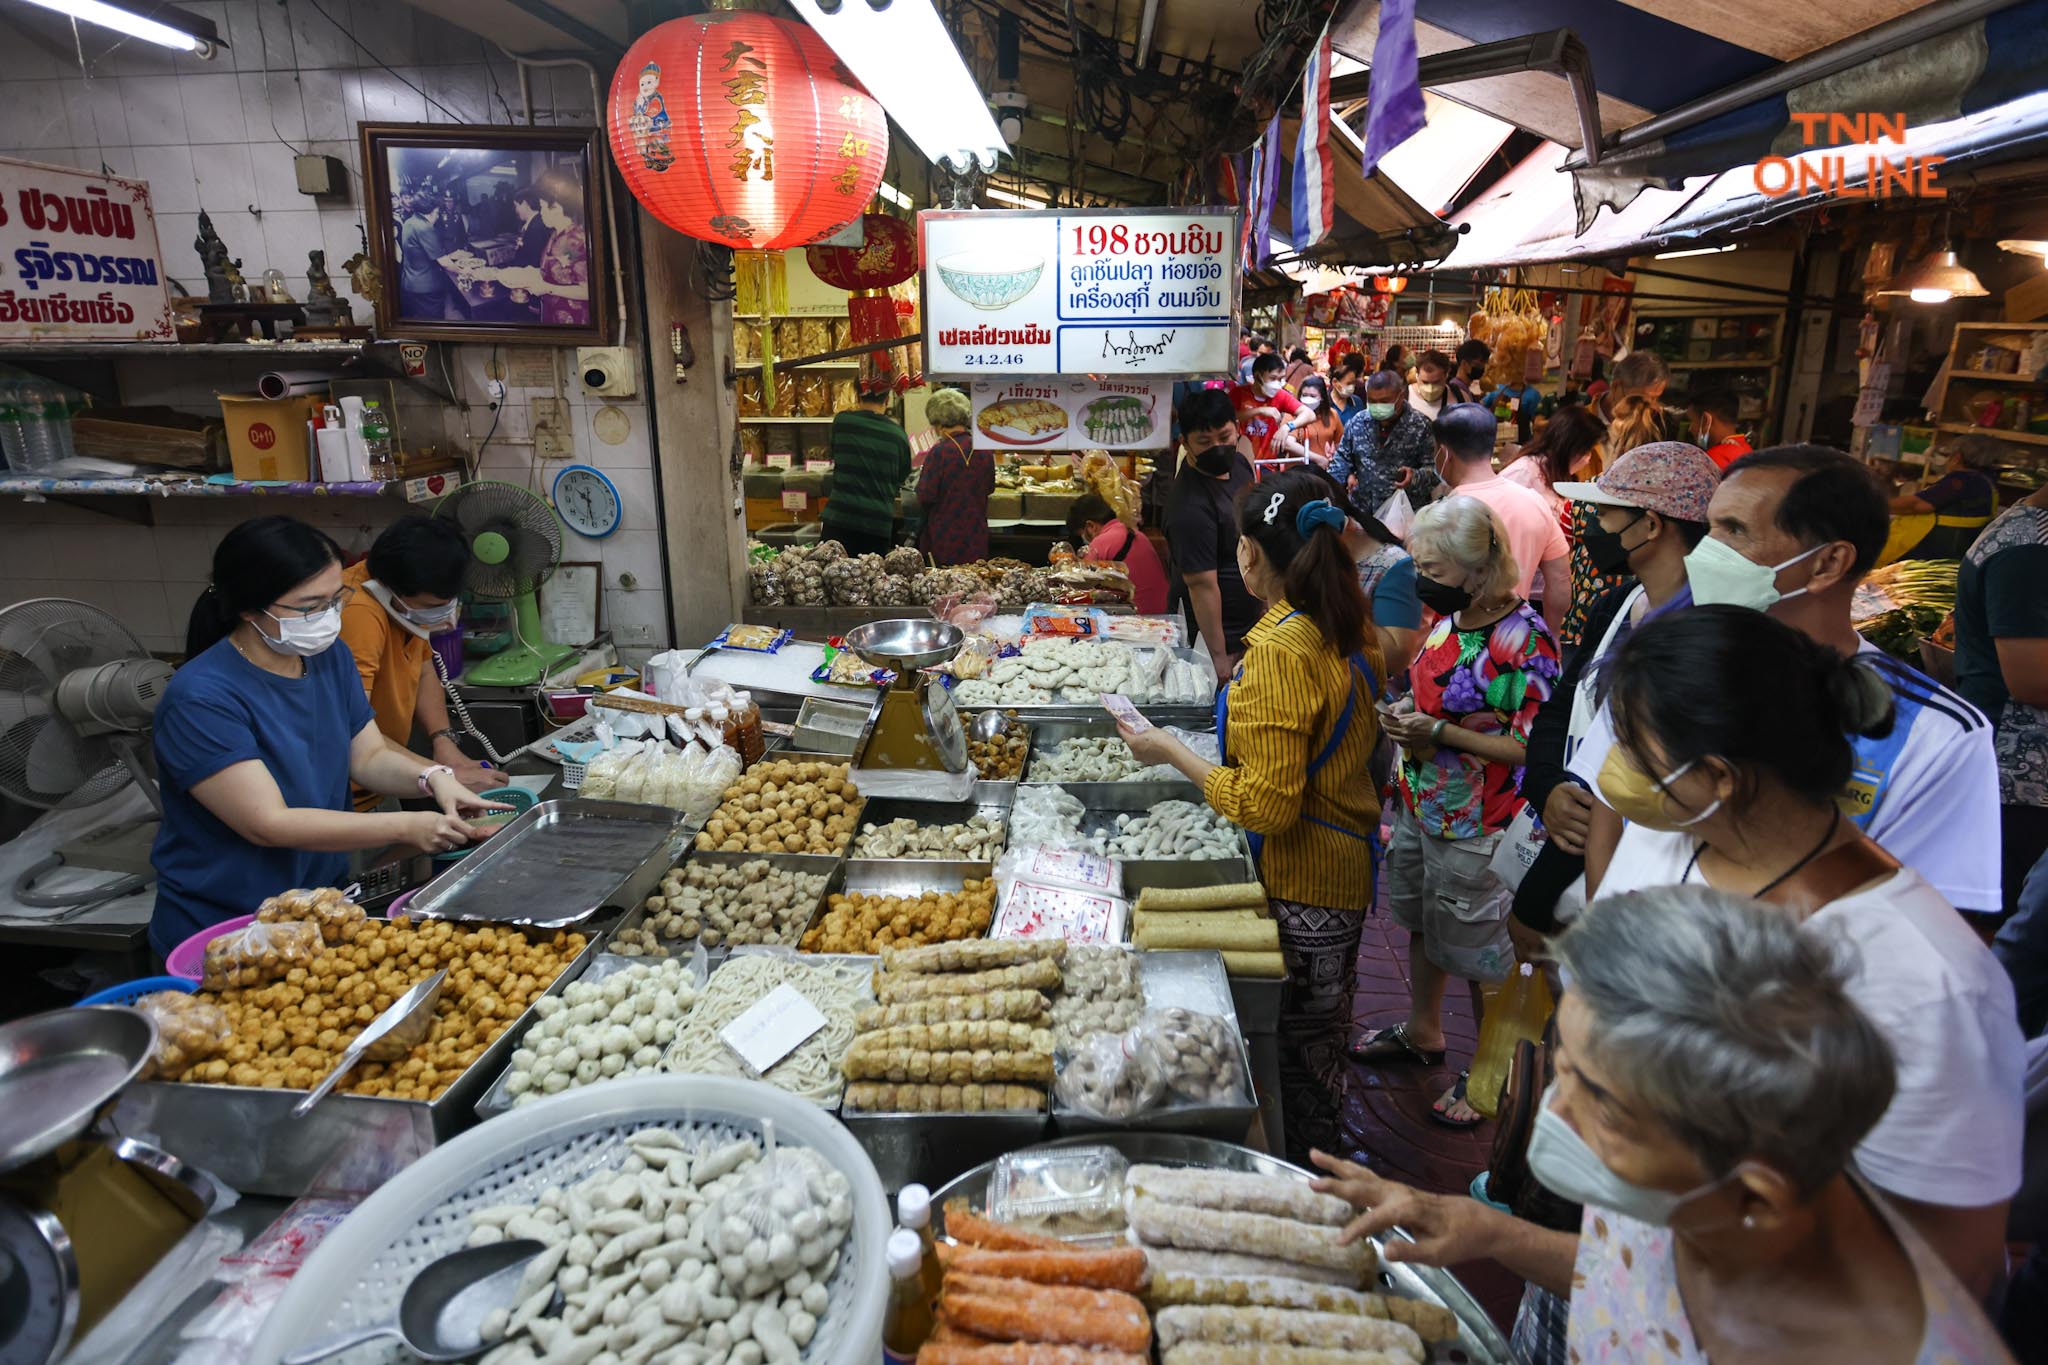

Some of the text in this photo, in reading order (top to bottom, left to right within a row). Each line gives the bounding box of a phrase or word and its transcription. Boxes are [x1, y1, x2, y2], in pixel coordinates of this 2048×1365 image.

[720, 41, 773, 181] 大吉大利
[18, 186, 136, 240] ชวนชิม
[1072, 223, 1223, 255] 198 ชวนชิม
[15, 241, 159, 290] รุจิราวรรณ
[1070, 256, 1222, 288] ลูกชิ้นปลา ห้อยจ๊อ
[1070, 282, 1221, 314] เครื่องสุกี้ ขนมจีบ
[938, 323, 1051, 346] เชลล์ชวนชิม
[404, 350, 422, 359] NO
[965, 353, 1024, 365] 24.2.46
